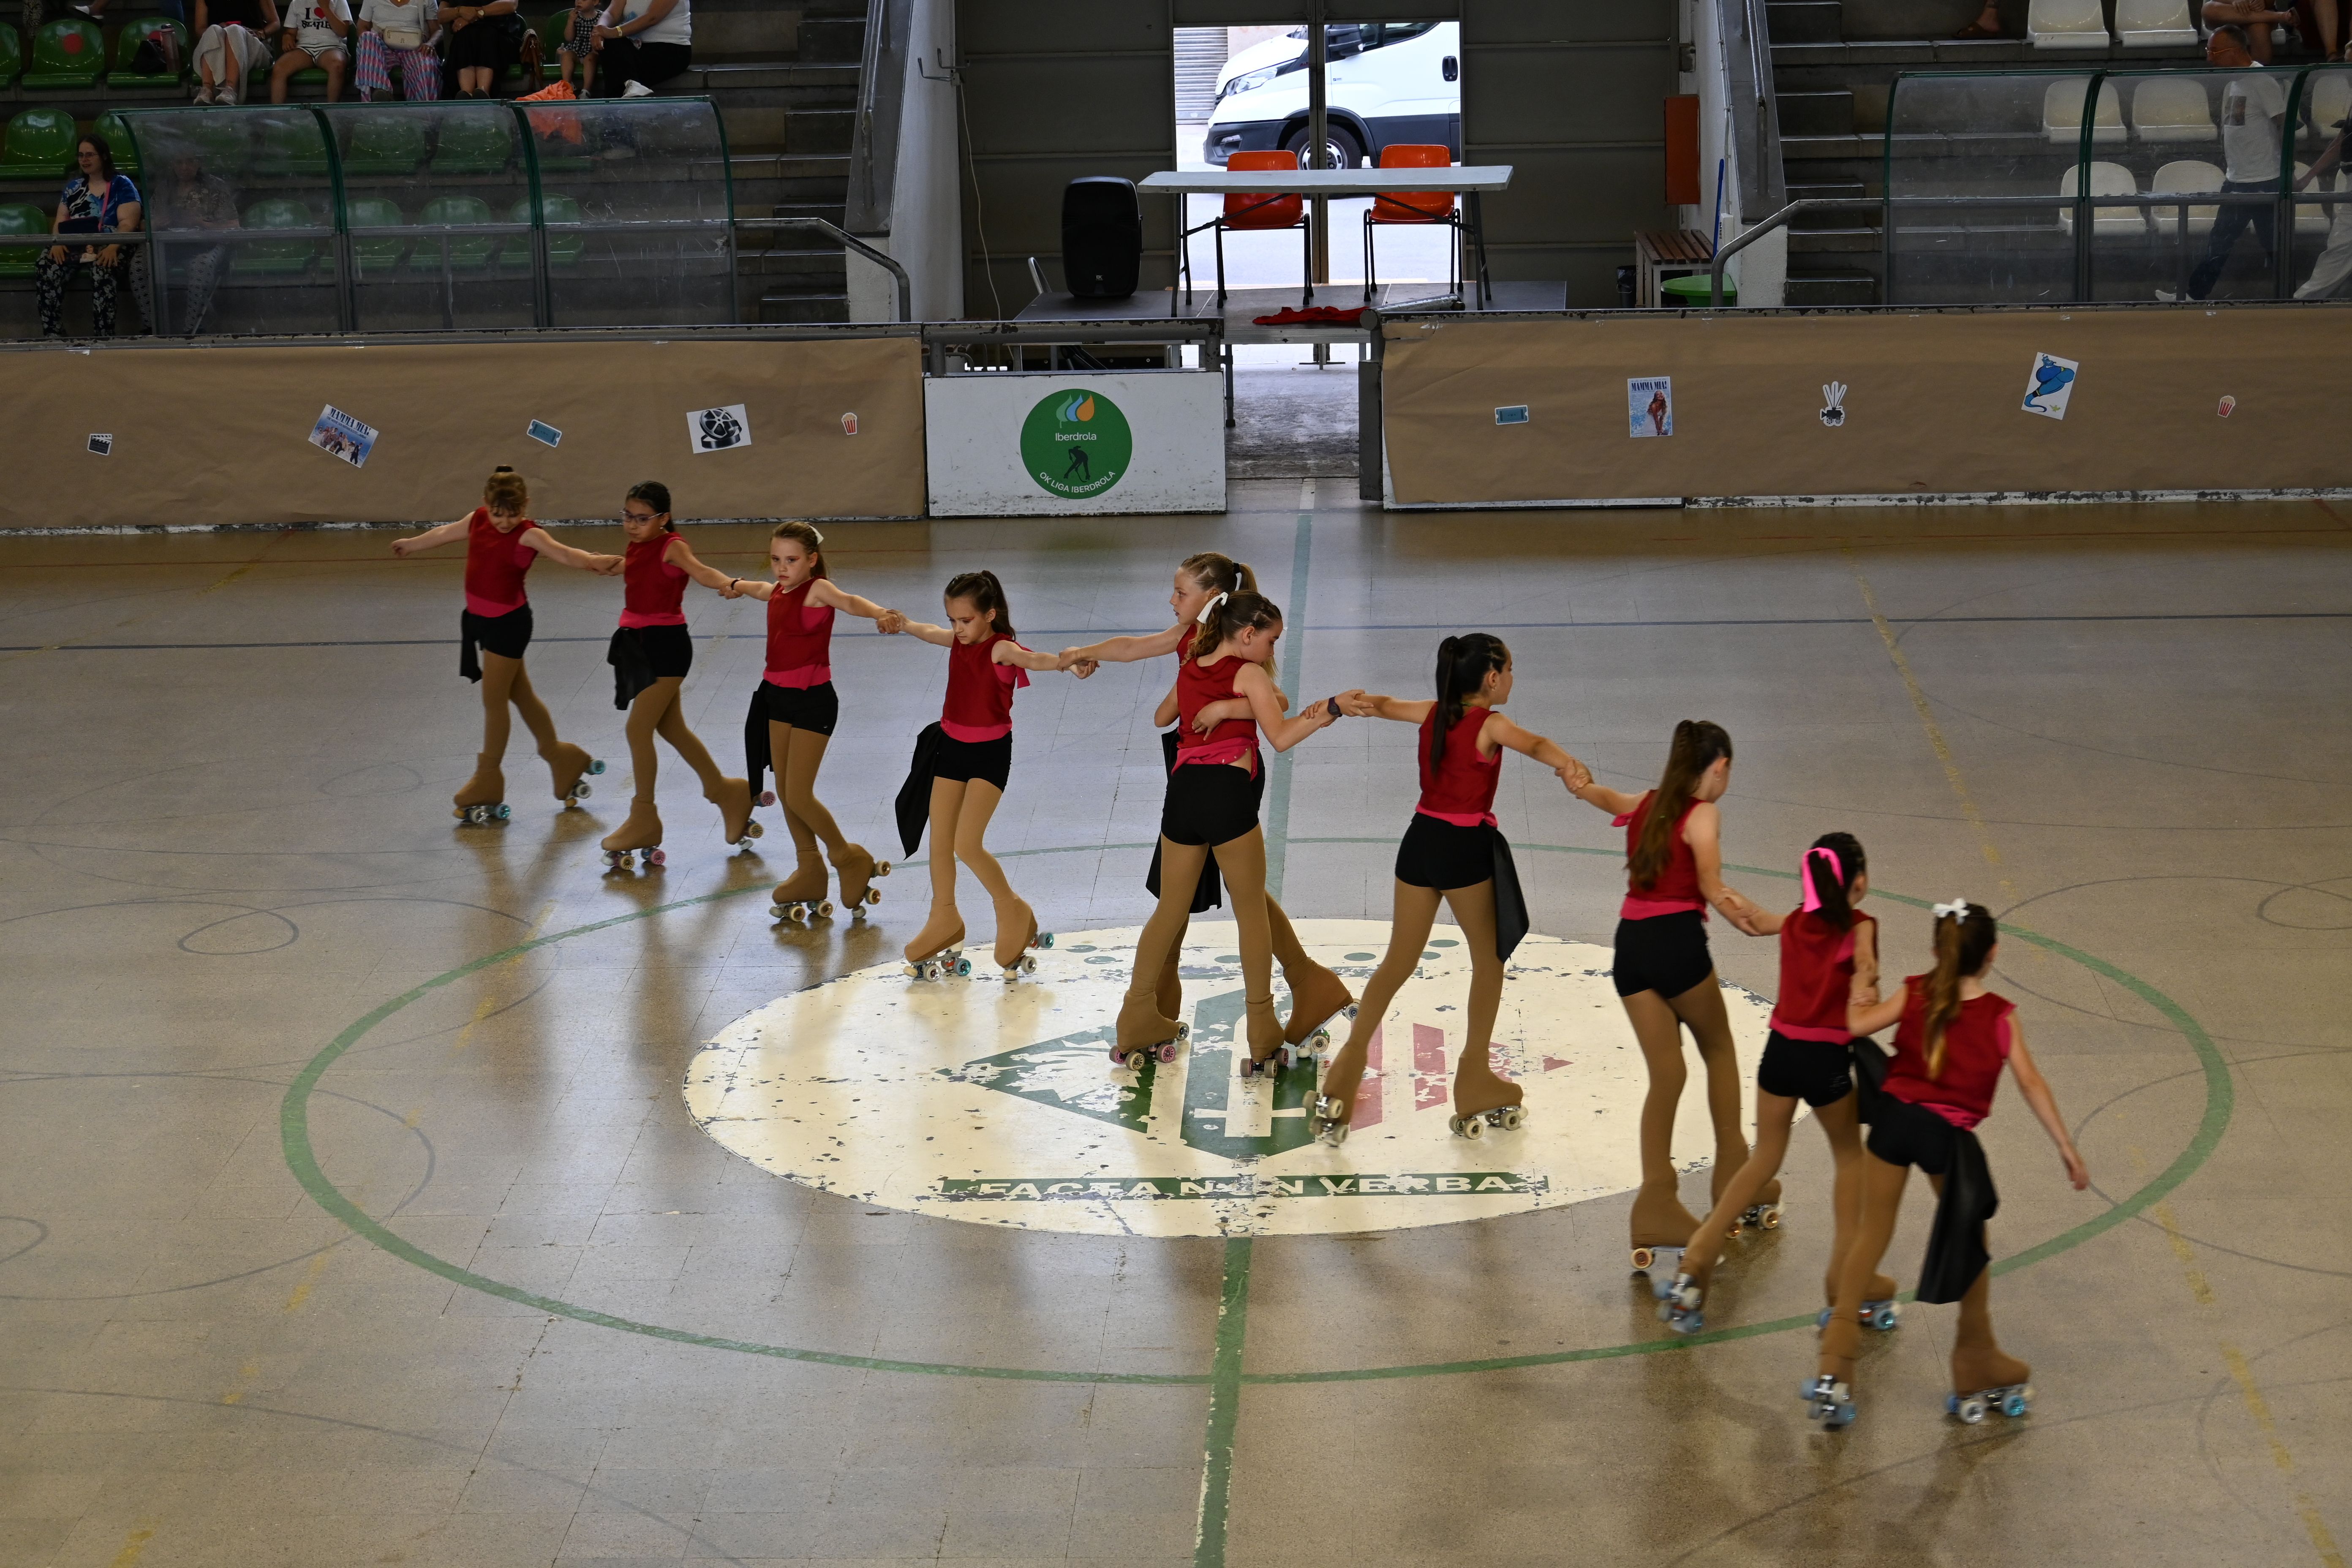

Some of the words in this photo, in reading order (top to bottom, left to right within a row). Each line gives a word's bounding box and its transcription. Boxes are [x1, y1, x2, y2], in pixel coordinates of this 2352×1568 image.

[305, 8, 311, 19] I
[301, 20, 332, 30] BEATLE
[1631, 382, 1653, 391] MAMMA
[1654, 381, 1667, 390] MIA!
[328, 408, 354, 427] MAMMA
[354, 422, 371, 436] MIA!
[1056, 432, 1097, 441] Iberdrola
[1040, 472, 1052, 484] OK
[1051, 480, 1069, 492] LIGA
[1071, 471, 1116, 493] IBERDROLA
[978, 1182, 1164, 1198] FACTA
[1319, 1176, 1513, 1193] VERBA
